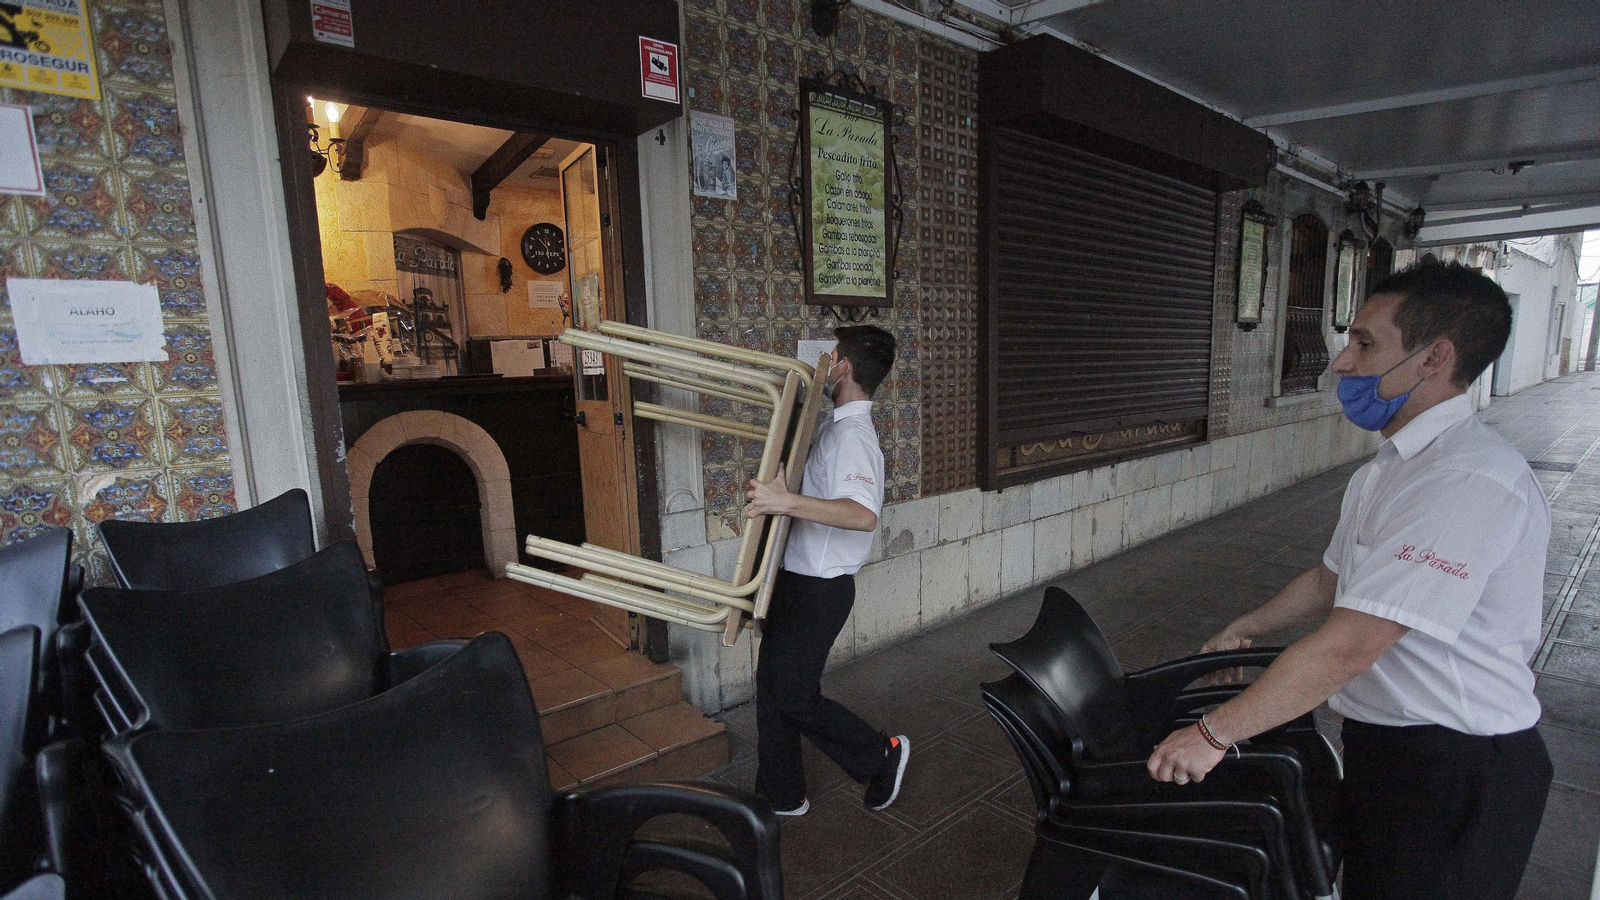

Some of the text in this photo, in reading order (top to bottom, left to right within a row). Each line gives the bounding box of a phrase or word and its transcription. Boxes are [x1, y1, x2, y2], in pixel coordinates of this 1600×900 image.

[0, 49, 89, 73] ROSEGUR
[815, 117, 878, 146] La Parada
[818, 147, 858, 165] Pescadito
[845, 188, 853, 197] en
[854, 189, 873, 201] adobo
[827, 198, 858, 213] Calamares
[827, 213, 861, 228] Boquerones
[822, 228, 847, 241] Gambas
[819, 243, 881, 259] Gambas a la plancha
[826, 259, 875, 273] Gambas cocidas
[846, 276, 850, 285] a
[852, 275, 857, 285] la
[858, 276, 881, 288] plancha
[1394, 544, 1469, 580] La Parada
